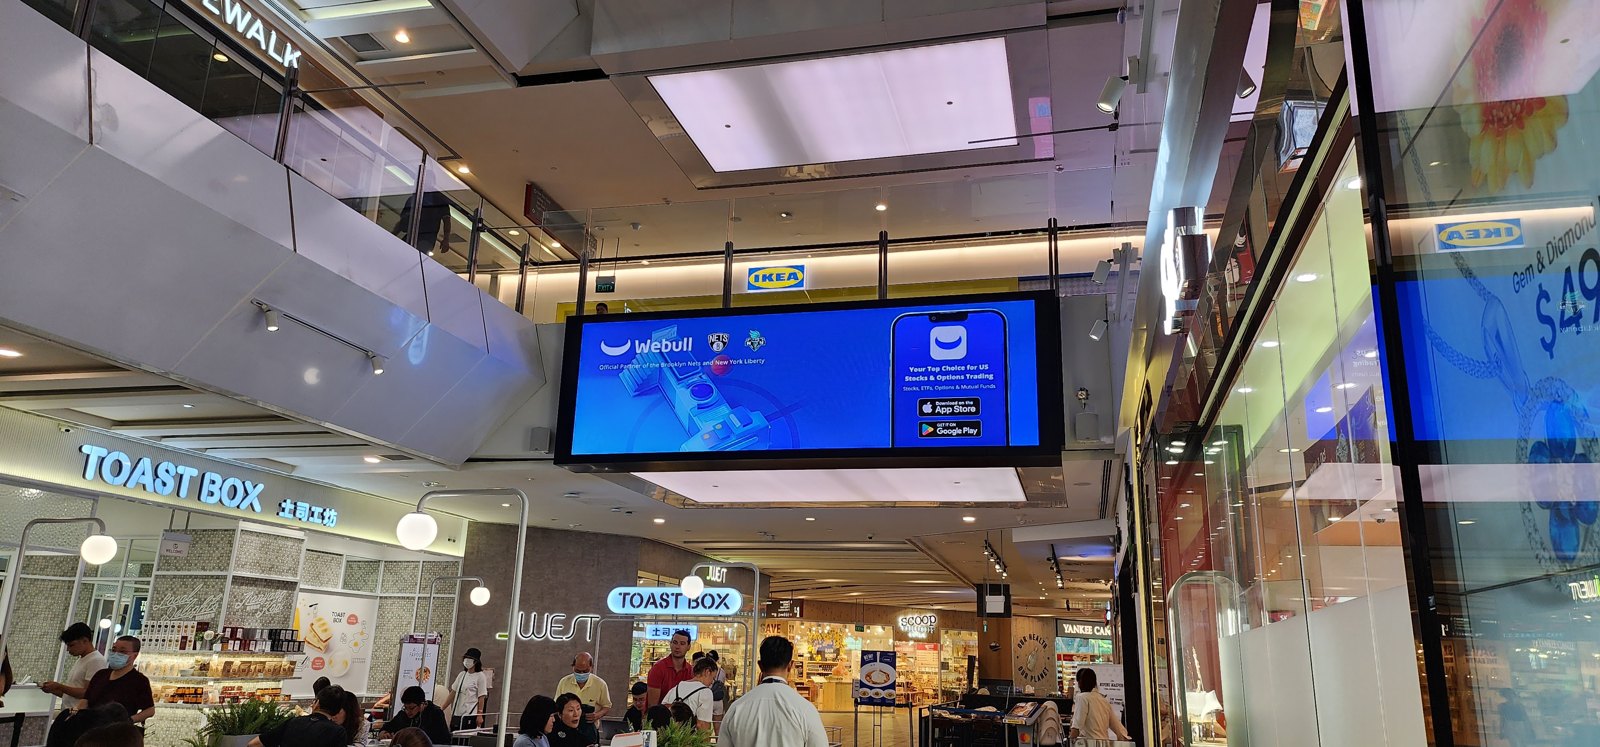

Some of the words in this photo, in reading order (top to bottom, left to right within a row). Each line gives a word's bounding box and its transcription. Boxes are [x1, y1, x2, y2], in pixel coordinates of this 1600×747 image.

[754, 272, 799, 283] IKEA
[1512, 264, 1534, 294] Gem
[1536, 251, 1546, 274] &
[708, 332, 729, 343] NETS
[635, 337, 693, 353] Webull
[661, 361, 687, 369] Brooklyn
[935, 406, 952, 414] App
[953, 405, 976, 413] Store
[936, 427, 962, 436] Google
[962, 427, 978, 435] Play
[79, 444, 198, 499] TOAST
[199, 471, 265, 513] BOX
[276, 499, 338, 528] 土司工坊
[618, 592, 684, 610] TOAST
[687, 592, 731, 610] BOX
[496, 611, 600, 642] WEST
[901, 615, 936, 626] scoop
[760, 624, 781, 633] SAVE
[1063, 624, 1093, 635] YANKEE
[1018, 636, 1027, 649] OUR
[1029, 634, 1048, 649] HEALTH
[1018, 666, 1028, 679] OUR
[1030, 667, 1050, 683] PLANET
